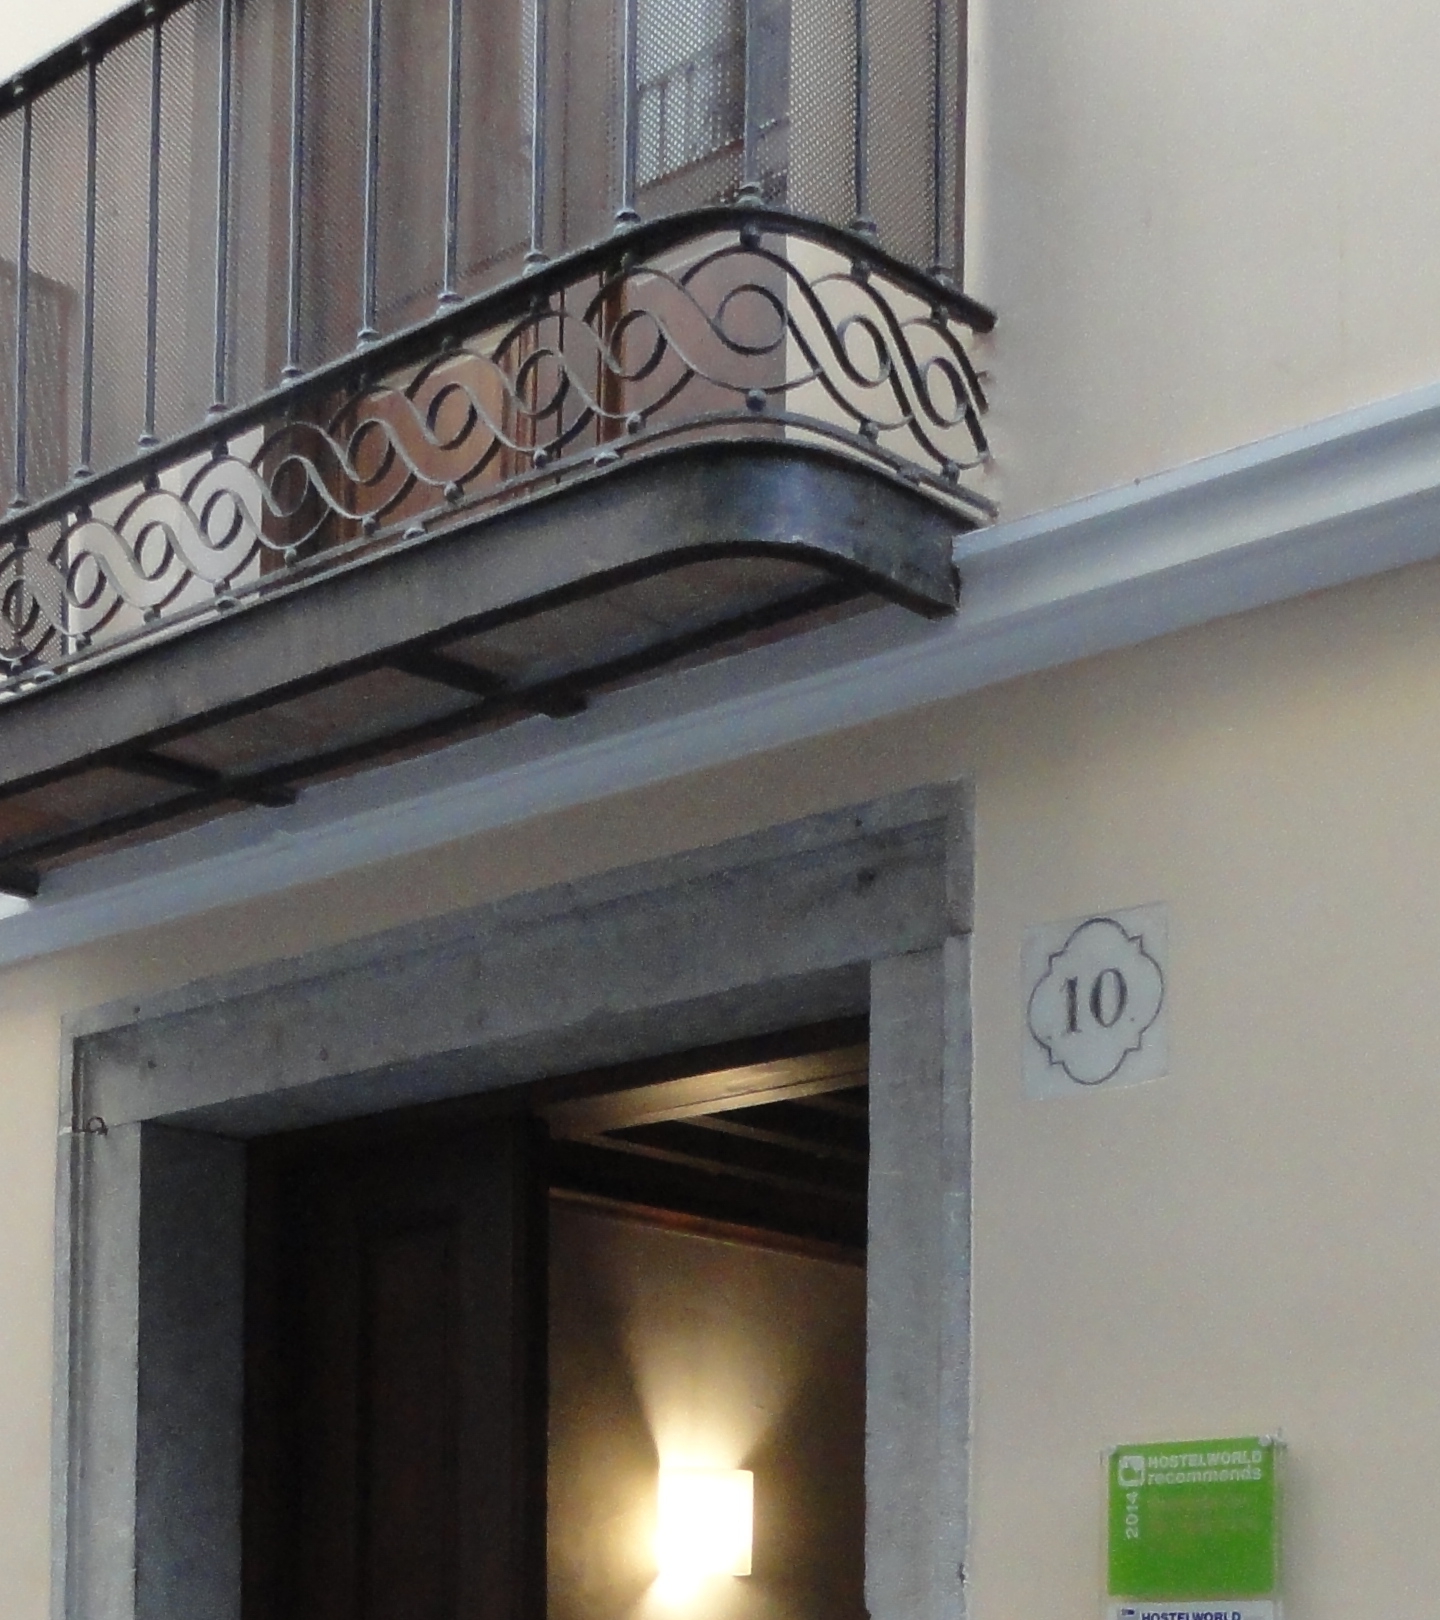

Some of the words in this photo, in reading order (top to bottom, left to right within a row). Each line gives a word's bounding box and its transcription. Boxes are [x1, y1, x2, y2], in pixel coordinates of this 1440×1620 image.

[1062, 967, 1128, 1035] 10
[1148, 1450, 1262, 1468] HOSTELWORLD
[1148, 1465, 1262, 1486] recommends
[1125, 1491, 1139, 1540] 2014
